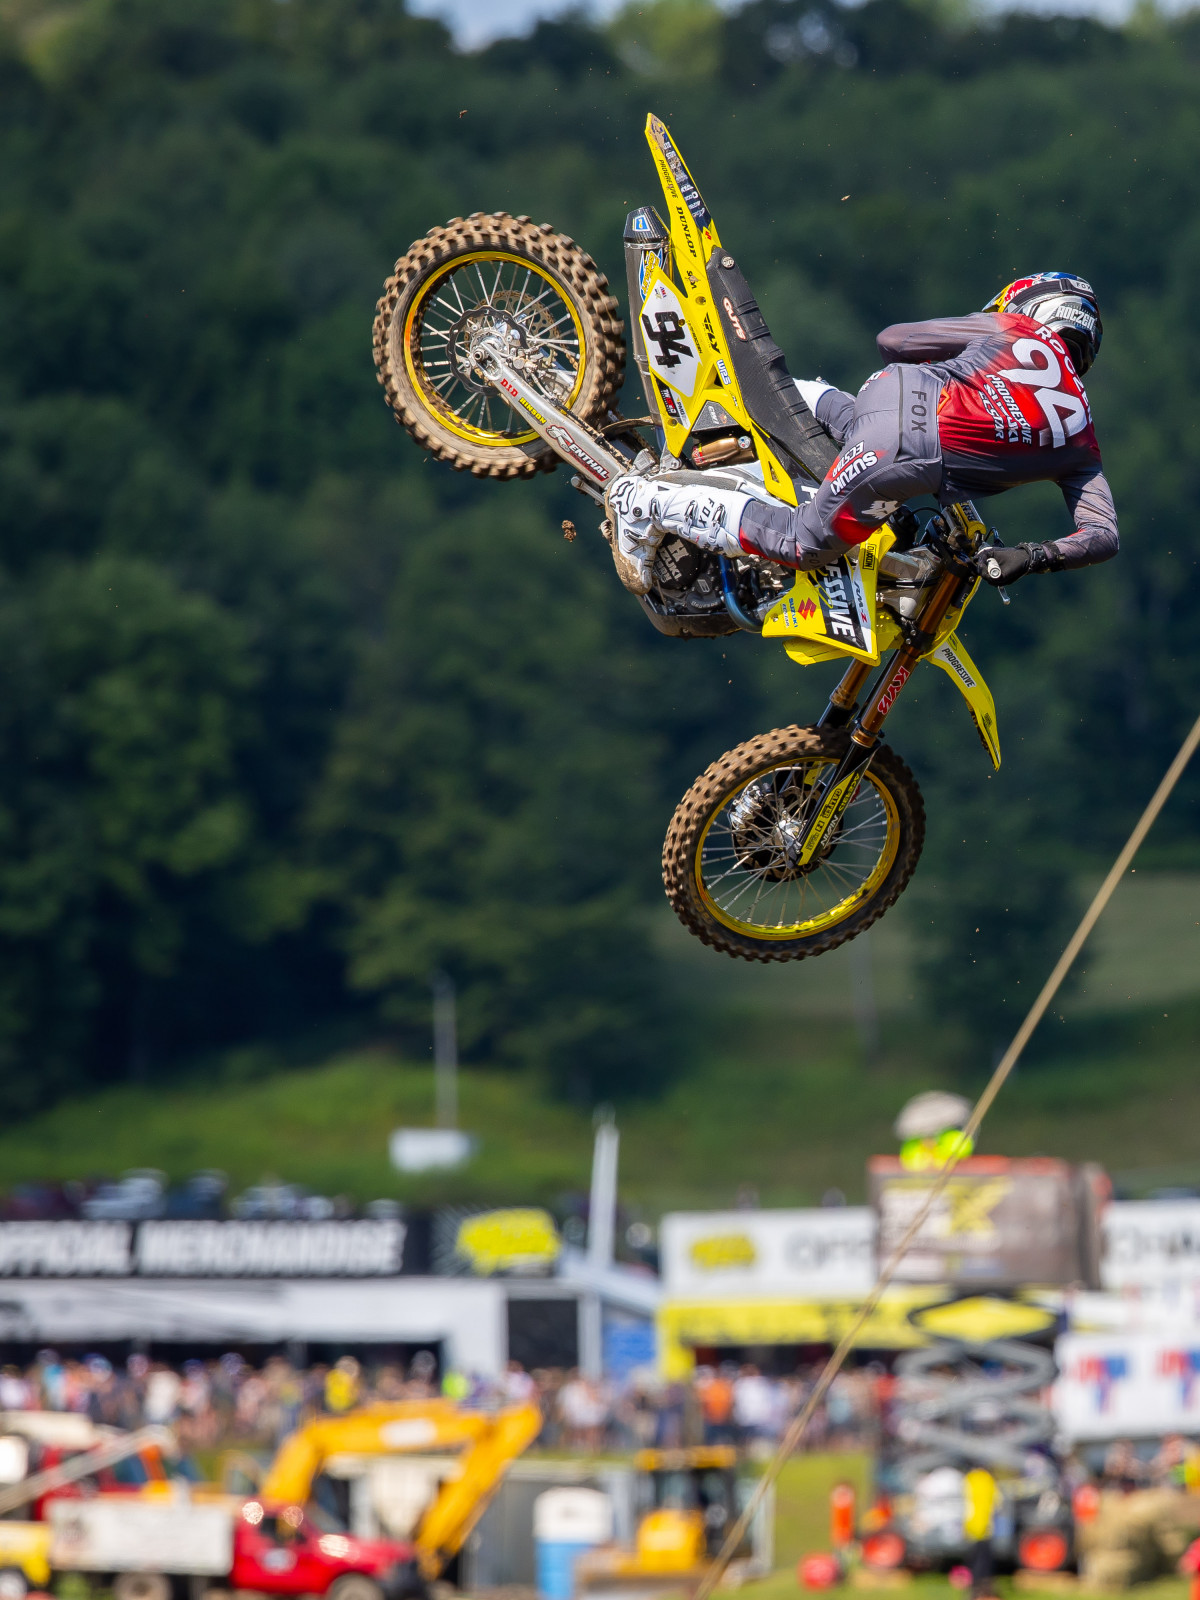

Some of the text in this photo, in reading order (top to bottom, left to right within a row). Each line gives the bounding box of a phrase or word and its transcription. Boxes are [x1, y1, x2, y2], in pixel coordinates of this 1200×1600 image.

[676, 206, 697, 258] DUNLOP
[642, 311, 694, 368] 94
[704, 312, 721, 354] FLY
[723, 297, 747, 341] GUTS
[1056, 305, 1095, 330] ROCZEN
[717, 359, 731, 385] WPS
[996, 338, 1088, 448] 94
[1035, 326, 1093, 424] ROCZEN
[519, 397, 547, 425] HINSON
[911, 390, 927, 434] FOX
[978, 391, 1005, 440] ECSTAR
[985, 374, 1032, 445] PROGRESSIVE
[546, 425, 610, 482] RENTHAL
[830, 451, 878, 496] SUZUKI
[832, 440, 864, 477] ECSTAR
[698, 497, 715, 528] FOX
[788, 597, 798, 628] SUZUKI
[824, 562, 856, 640] ESSIVE
[942, 647, 975, 688] PROGRESSIVE
[877, 665, 910, 715] KYB
